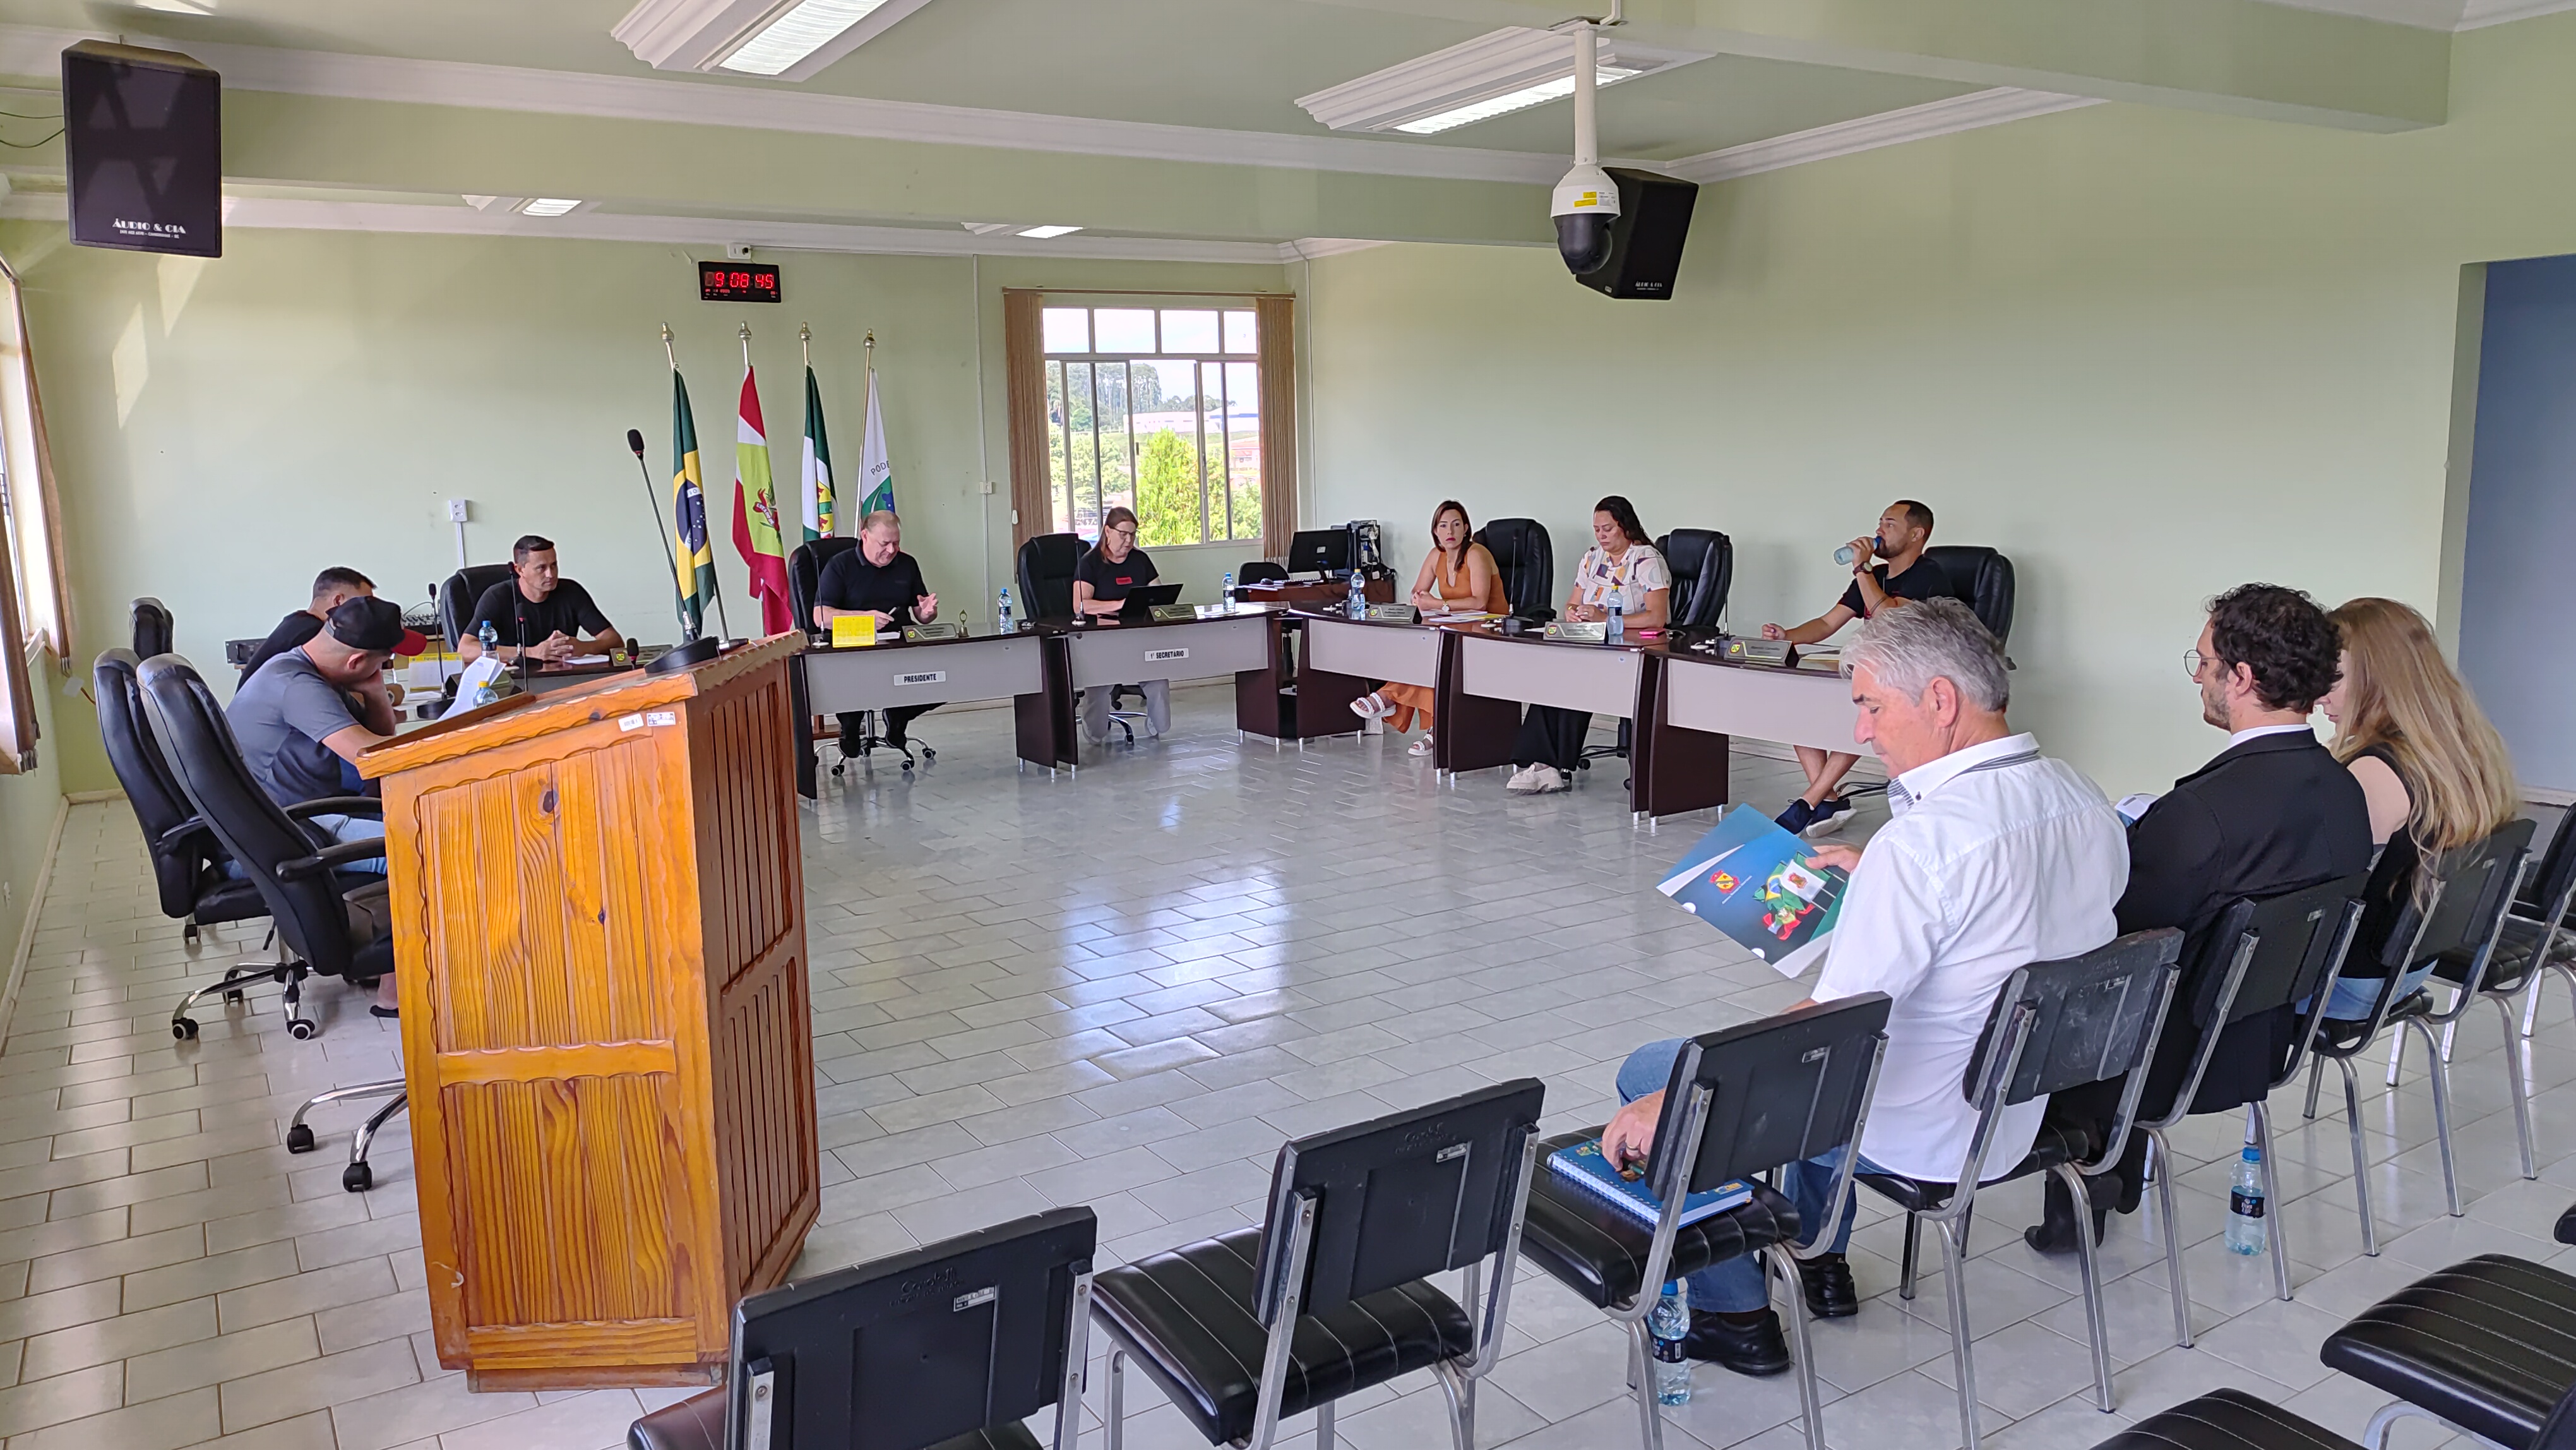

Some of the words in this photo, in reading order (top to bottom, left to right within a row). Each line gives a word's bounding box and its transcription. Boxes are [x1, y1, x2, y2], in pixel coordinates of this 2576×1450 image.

[112, 218, 150, 231] ÁUDIO
[153, 223, 162, 232] &
[165, 224, 186, 234] CIA
[903, 673, 937, 683] PRESIDENTE
